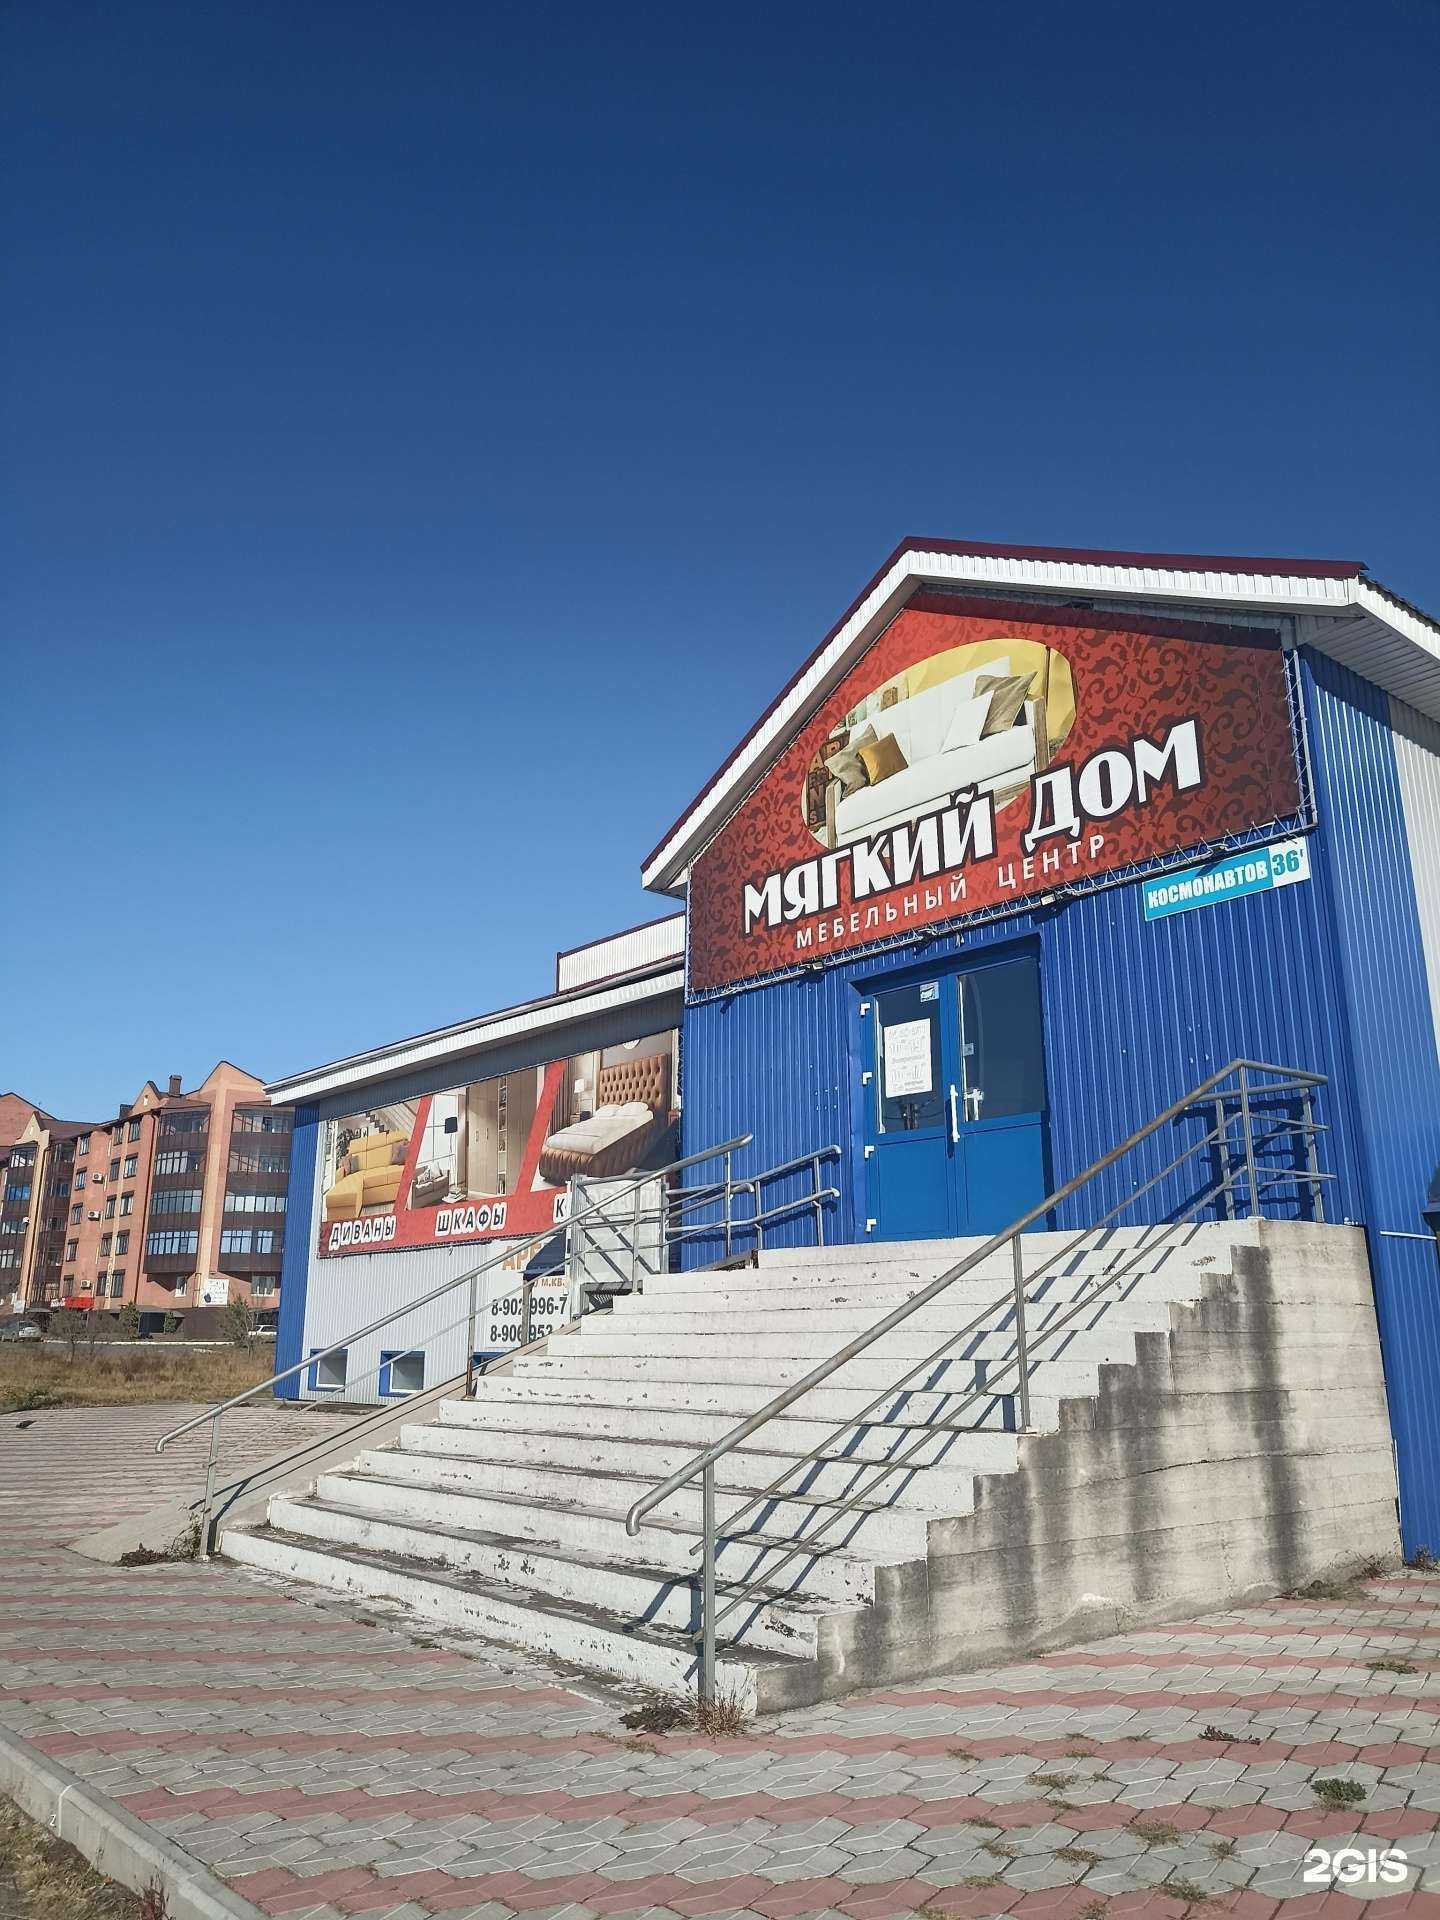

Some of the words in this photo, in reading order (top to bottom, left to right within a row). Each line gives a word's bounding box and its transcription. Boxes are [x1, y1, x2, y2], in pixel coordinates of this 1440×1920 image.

[743, 788, 992, 934] МЯГКИЙ
[1024, 720, 1200, 852] ДОМ
[796, 873, 967, 948] МЕБЕЛЬНЫЙ
[998, 835, 1105, 889] ЦЕНТР
[1147, 861, 1269, 908] КОСМОНАВТОВ
[331, 1217, 397, 1248] ДИВАНЫ
[438, 1202, 505, 1233] ШКАФЫ
